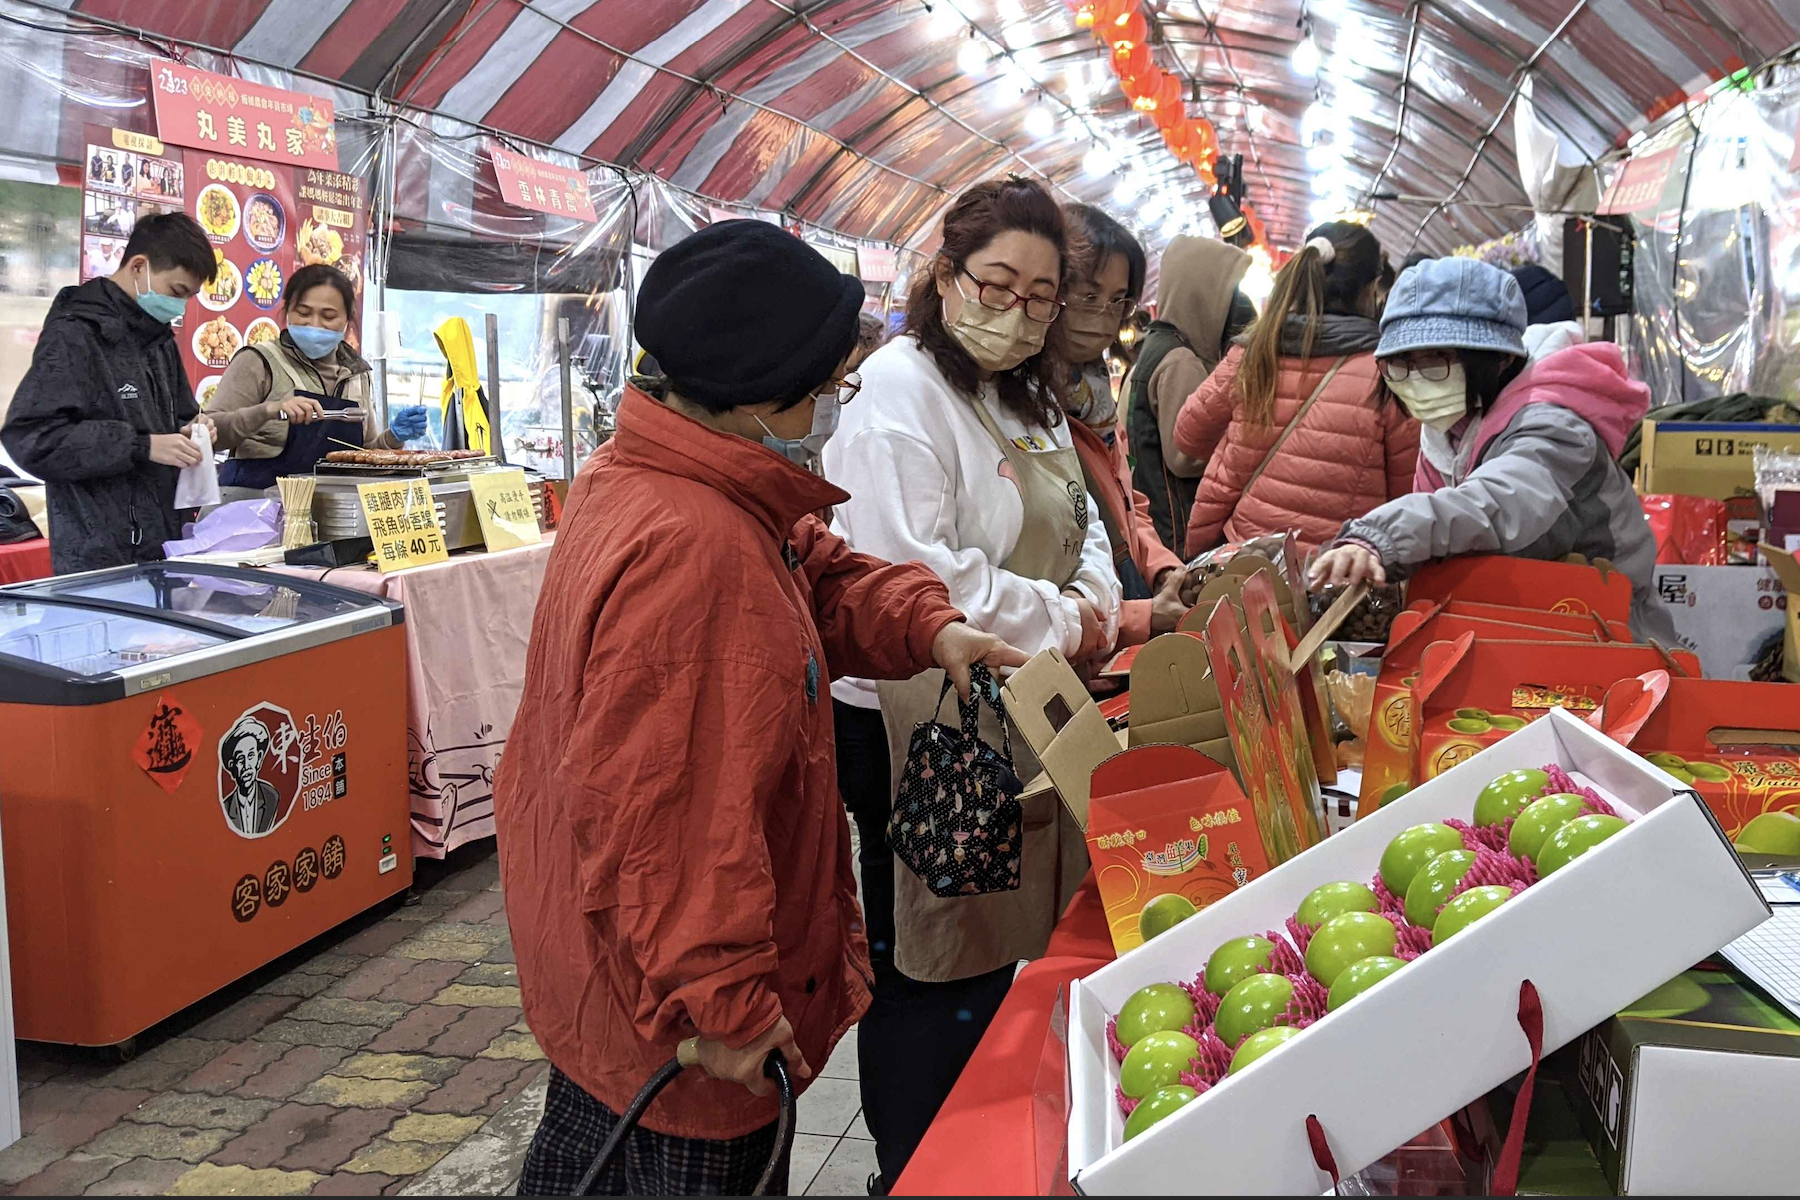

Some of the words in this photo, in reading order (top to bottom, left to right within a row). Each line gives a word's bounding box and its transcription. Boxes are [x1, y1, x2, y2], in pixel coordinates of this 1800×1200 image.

[196, 109, 305, 156] 丸美丸家
[518, 180, 578, 213] 雲林青農
[372, 511, 435, 538] 飛魚卵香腸
[381, 541, 409, 561] 每條
[410, 538, 426, 555] 40
[427, 533, 441, 553] 元
[1658, 574, 1686, 604] 屋
[302, 763, 331, 787] Since
[302, 782, 333, 811] 1894
[1189, 808, 1241, 831] 色味俱佳
[1227, 841, 1251, 887] 嚴選蜜
